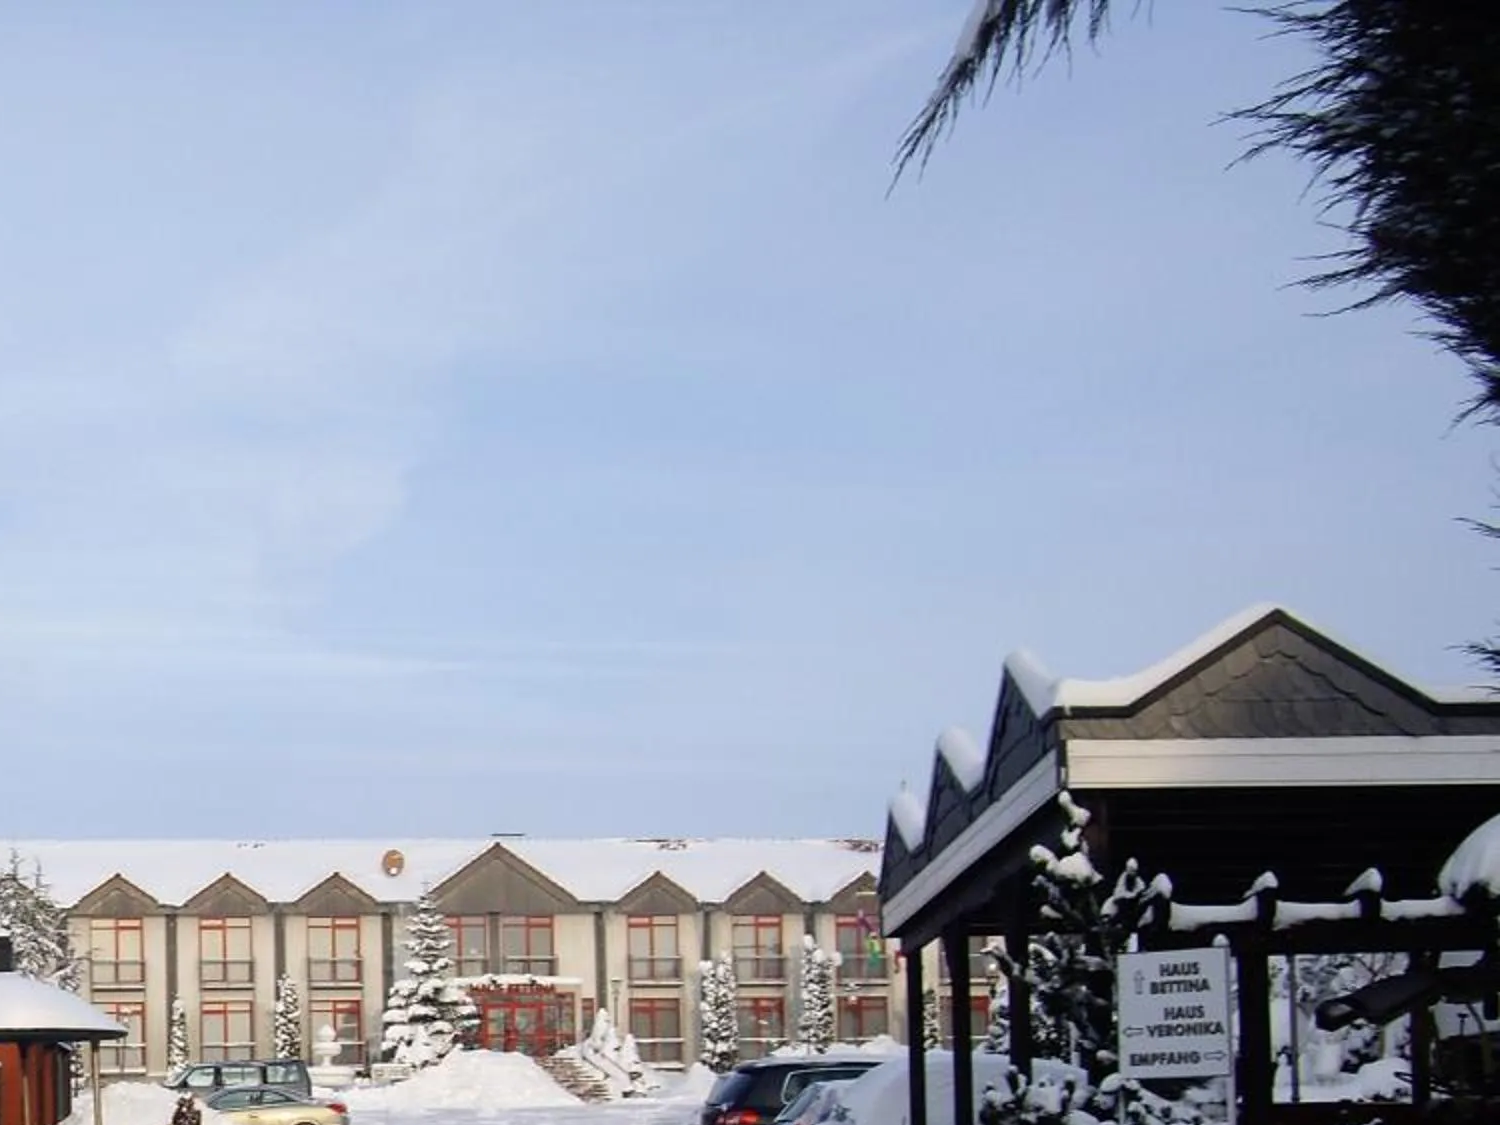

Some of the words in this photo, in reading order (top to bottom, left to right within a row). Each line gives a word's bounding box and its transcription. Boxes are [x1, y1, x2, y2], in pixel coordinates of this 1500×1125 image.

[1159, 962, 1200, 976] HAUS
[1149, 978, 1210, 995] BETTINA
[1164, 1005, 1205, 1020] HAUS
[1146, 1021, 1225, 1037] VERONIKA
[1129, 1051, 1201, 1067] EMPFANG
